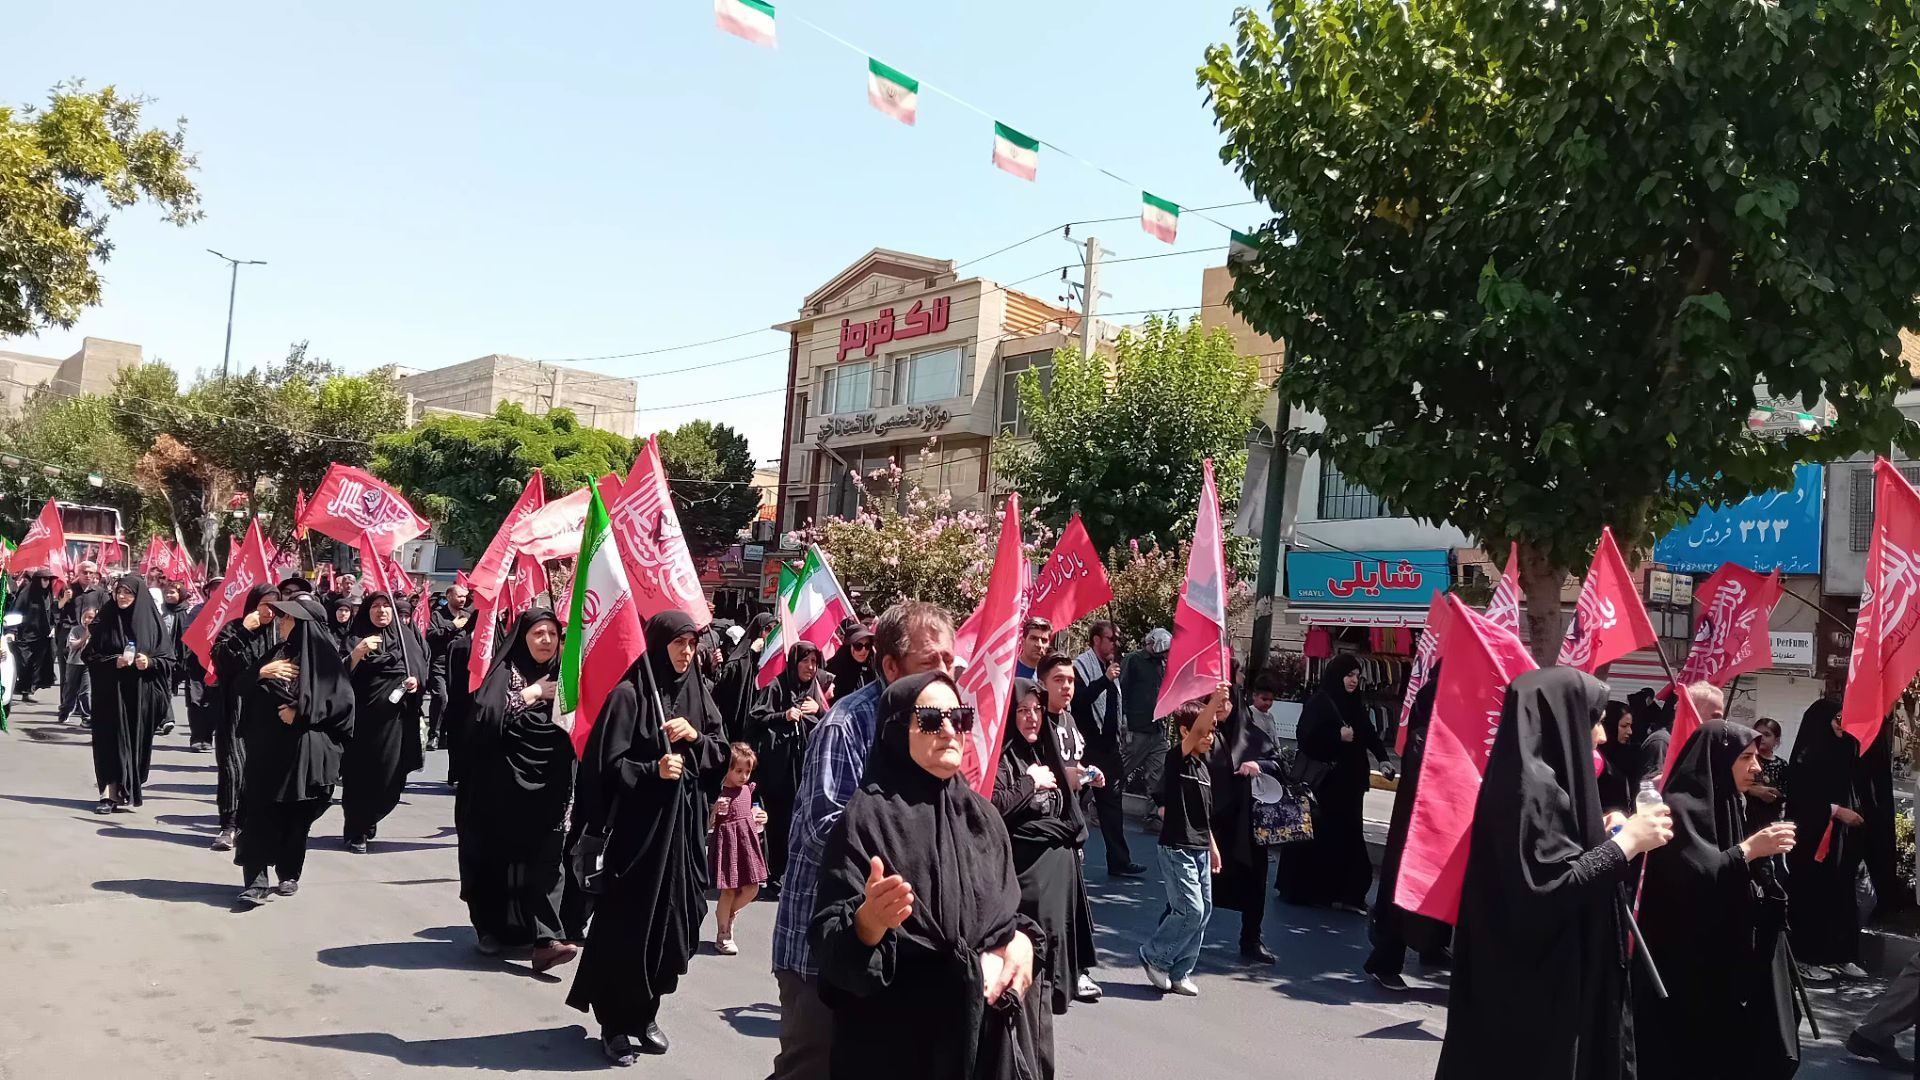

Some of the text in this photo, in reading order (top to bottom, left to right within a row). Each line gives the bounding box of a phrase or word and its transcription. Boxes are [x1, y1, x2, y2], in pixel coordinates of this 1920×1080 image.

[837, 296, 951, 362] لاک قرمز
[920, 404, 952, 432] مرکز
[1688, 518, 1732, 548] فردیس
[1739, 519, 1789, 543] ۳۲۳
[1328, 559, 1423, 598] شایلی
